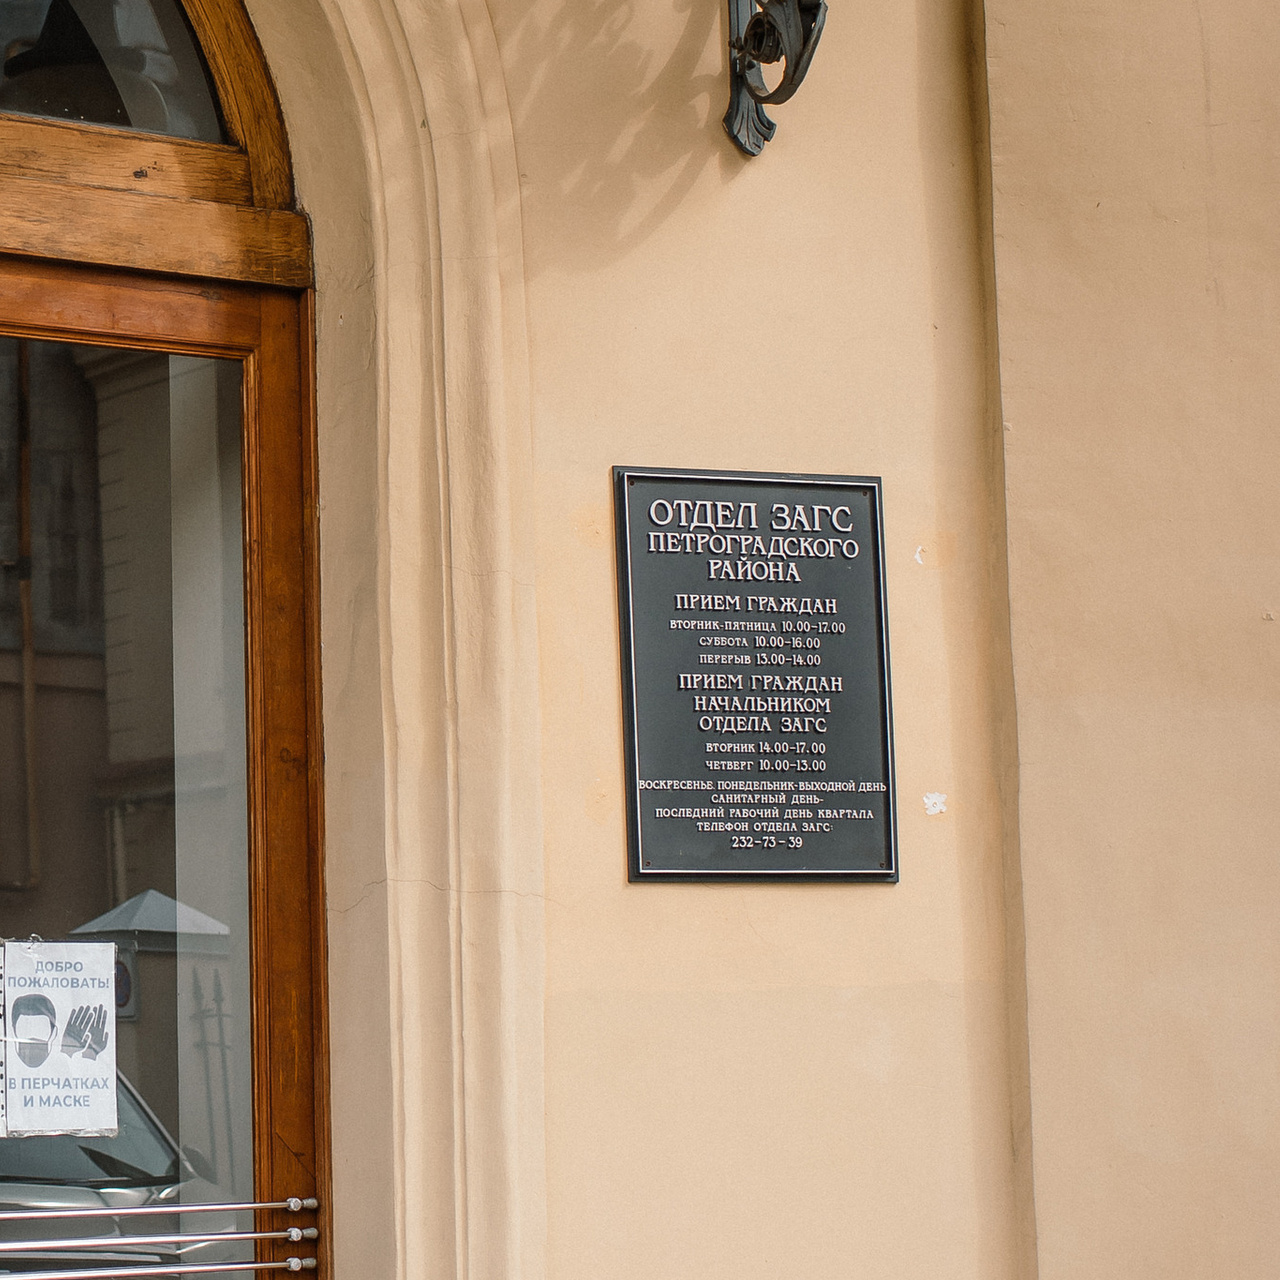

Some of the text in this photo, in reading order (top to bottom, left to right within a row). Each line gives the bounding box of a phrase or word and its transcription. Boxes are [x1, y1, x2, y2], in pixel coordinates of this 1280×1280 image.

[650, 499, 853, 532] ОТДЕЛ ЗАГС
[648, 532, 859, 559] ПЕТРОГРАДСКОГО
[708, 557, 801, 582] РАЙОНА
[676, 594, 837, 615] ПРИЕМ ГРАЖДАН
[670, 620, 846, 634] ВТОРНИК-ПЯТНИЦА 10.00-17.00
[699, 636, 820, 649] СУББОТА 10.00-16.00
[699, 654, 821, 666] ПЕРЕРЫВ 13.00-14.00
[679, 674, 843, 692] ПРИЕМ ГРАЖДАН
[694, 696, 830, 712] НАЧАЛЬНИКОМ
[700, 716, 827, 733] ОТДЕЛА ЗАГС
[706, 742, 826, 754] ВТОРНИК 14.00-17.00
[706, 760, 826, 771] ЧЕТВЕРГ 10.00-13.00
[858, 782, 886, 792] ДЕНЬ
[711, 793, 786, 804] САНИТАРНЫЙ
[656, 806, 874, 819] ПОСЛЕДНИЙ РАБОЧИЙ ДЕНЬ КВАРТАЛА
[696, 822, 748, 832] ТЕЛЕФОН
[754, 822, 797, 832] ОТДЕЛА
[35, 961, 83, 974] ДОБРО
[8, 977, 109, 989] ПОЖАЛОВАТЬ!
[9, 1078, 109, 1089] В ПЕРЧАТКАХ
[24, 1095, 90, 1107] И МАСКЕ
